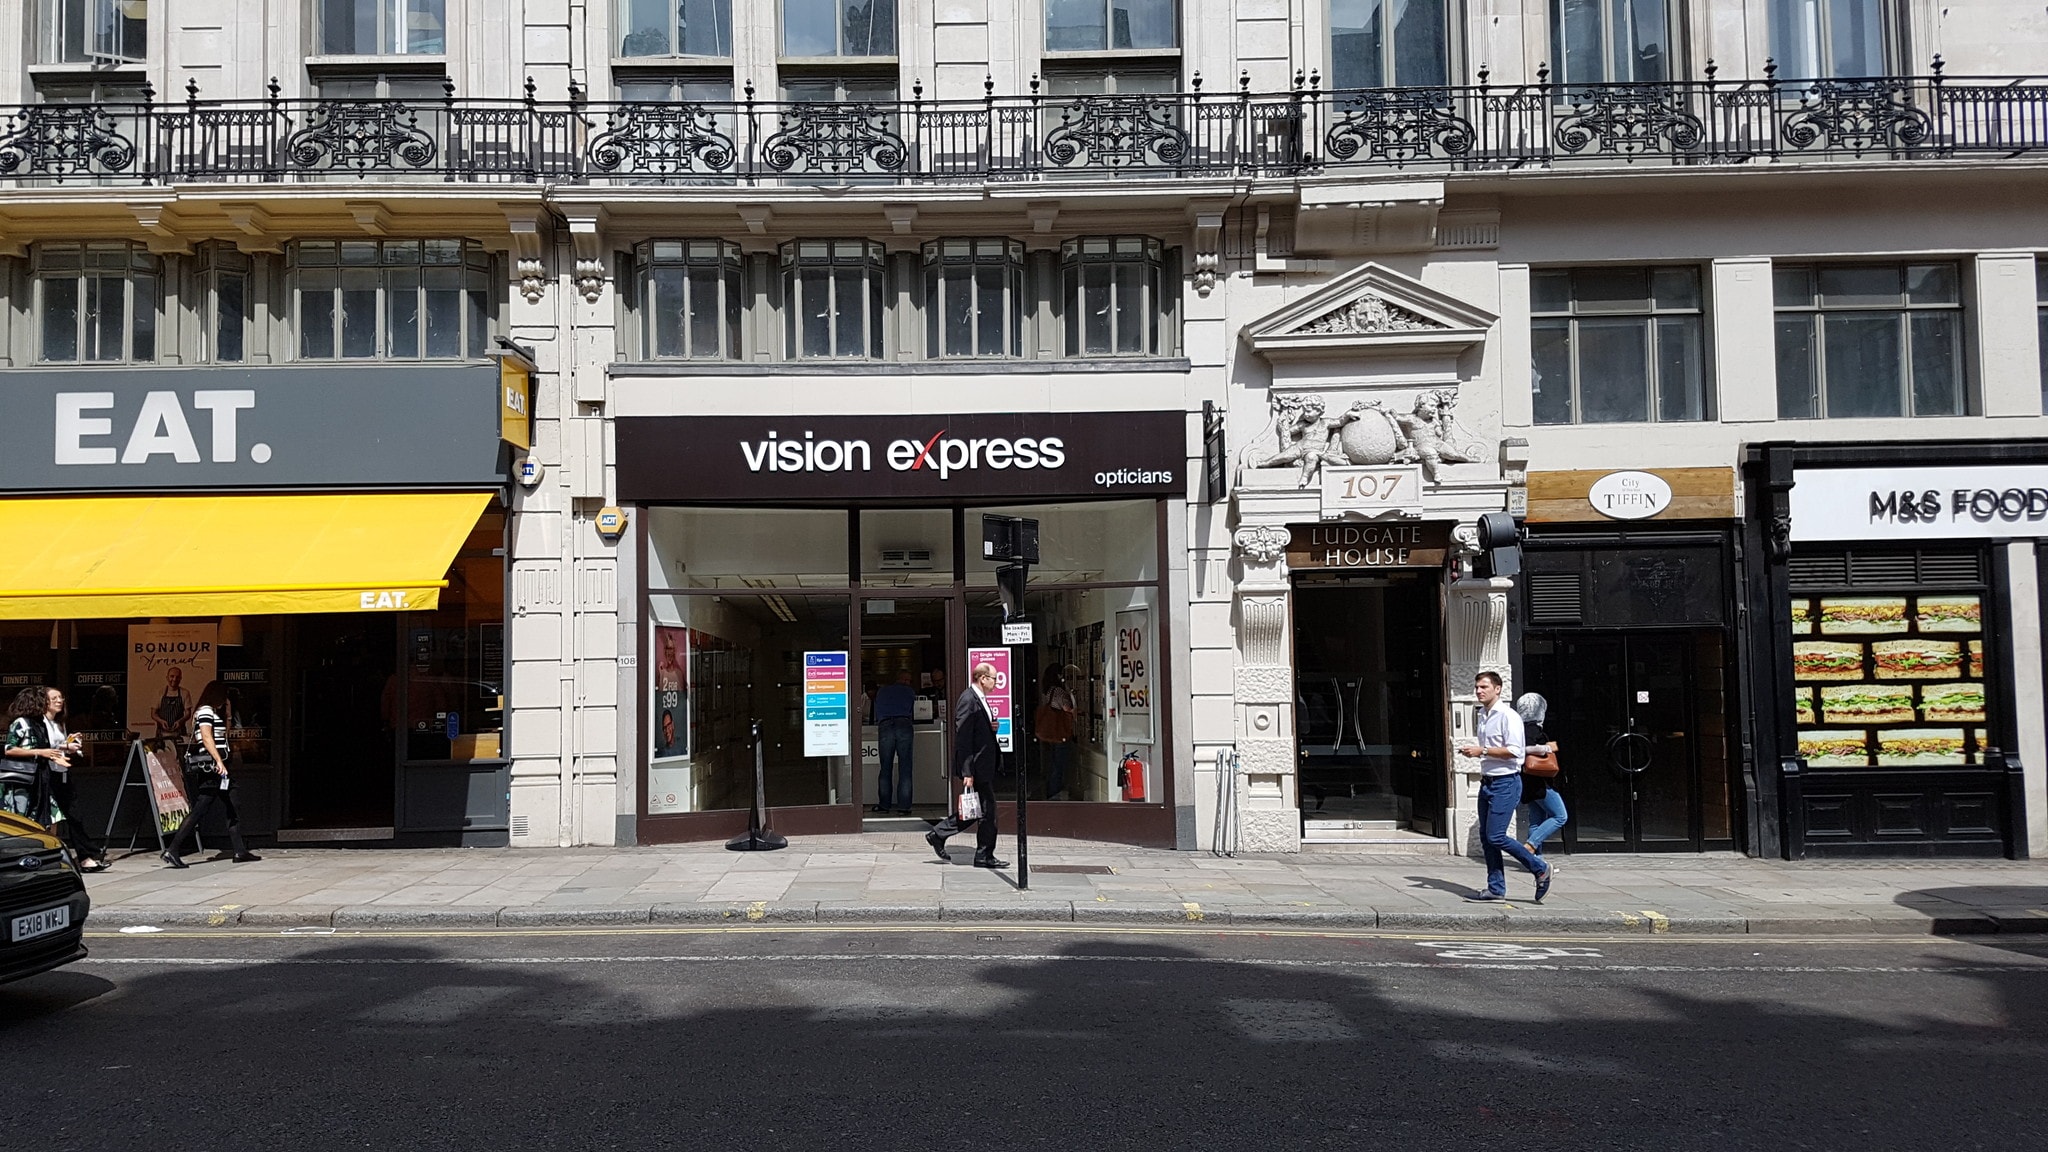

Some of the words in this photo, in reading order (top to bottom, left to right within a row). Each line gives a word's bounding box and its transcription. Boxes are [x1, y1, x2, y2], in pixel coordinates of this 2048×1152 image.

[55, 390, 272, 465] EAT.
[741, 431, 870, 472] vision
[886, 429, 1065, 479] express
[1094, 468, 1172, 487] opticians
[1621, 478, 1640, 488] City
[1340, 475, 1402, 500] 107
[1603, 493, 1656, 508] TIFFIN
[1870, 490, 1941, 520] M&S
[602, 516, 616, 525] ADT
[1312, 526, 1421, 545] LUDGATE
[1325, 548, 1408, 566] HOUSE
[360, 591, 409, 609] EAT.
[134, 641, 210, 653] BONJOUR
[1120, 628, 1141, 651] £10
[620, 657, 636, 665] 108
[1120, 655, 1144, 682] Eye
[2, 676, 28, 684] DINNER
[77, 675, 103, 683] COFFEE
[223, 672, 249, 680] DINNER
[662, 677, 668, 691] 2
[668, 681, 678, 691] FOR
[662, 691, 678, 708] £99
[1121, 684, 1149, 708] Test
[18, 915, 43, 937] EX18
